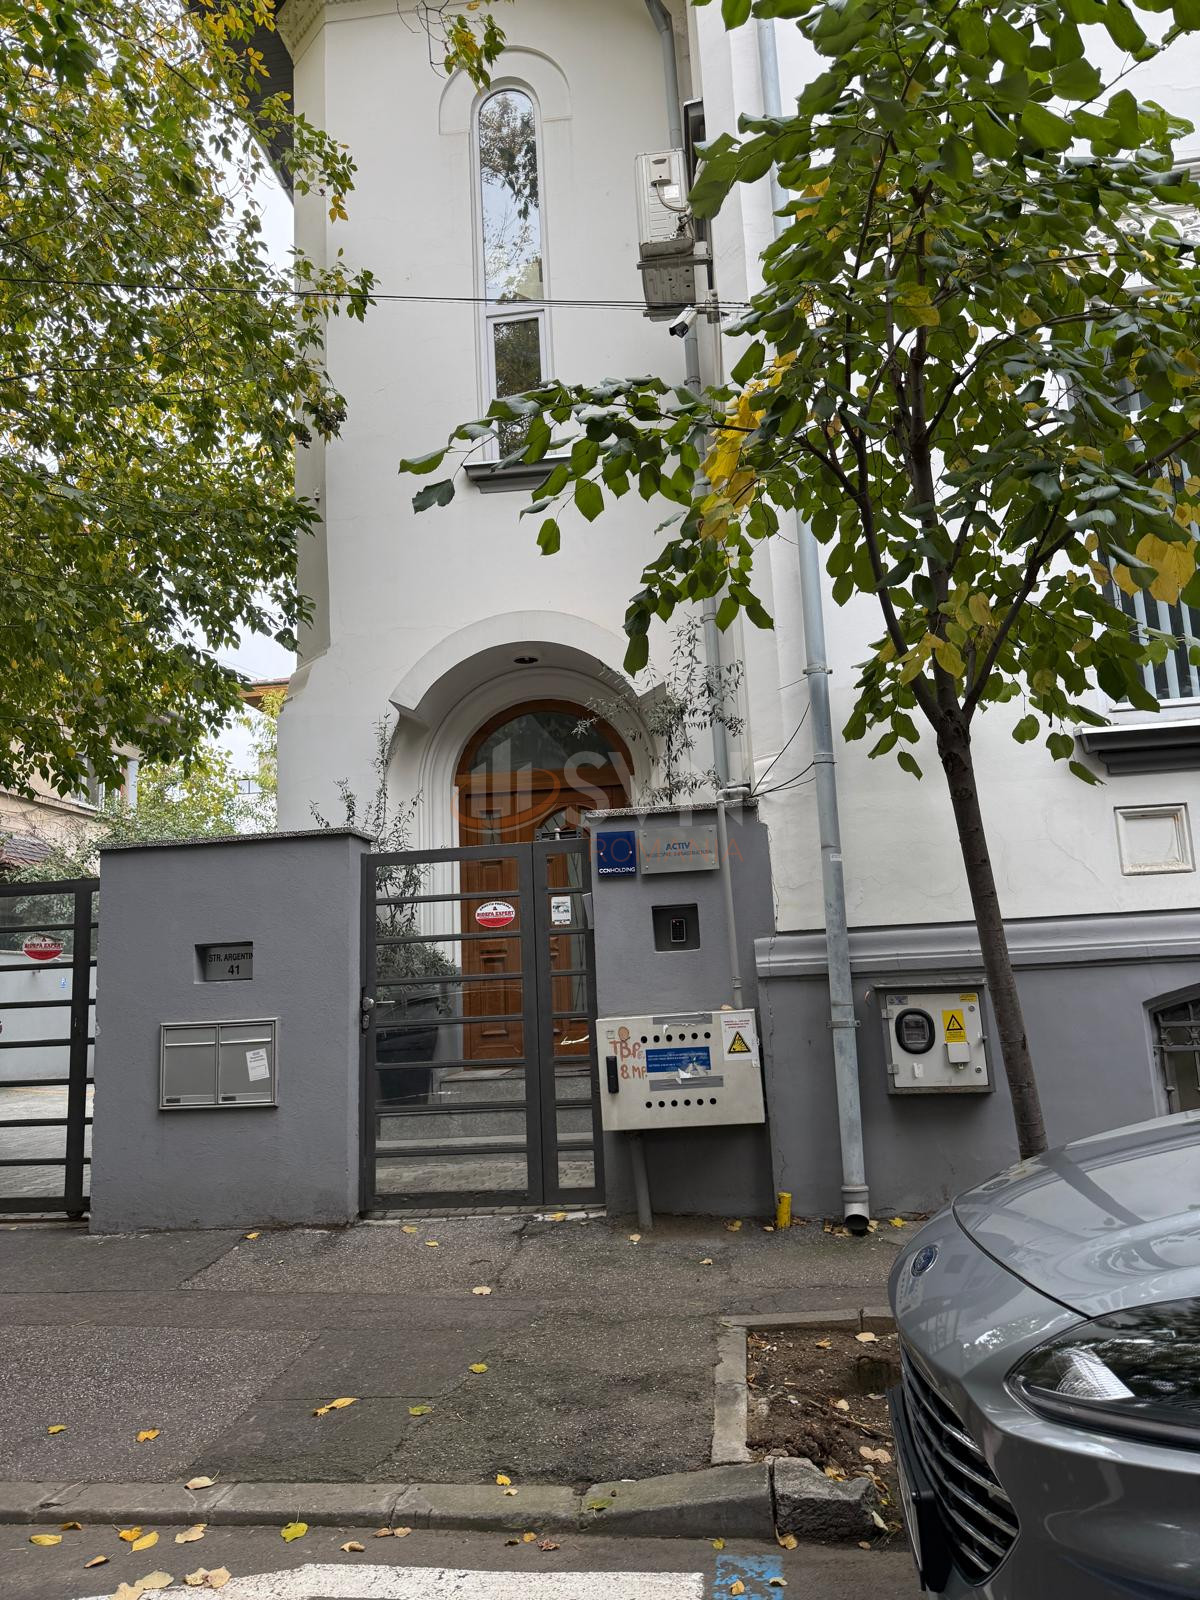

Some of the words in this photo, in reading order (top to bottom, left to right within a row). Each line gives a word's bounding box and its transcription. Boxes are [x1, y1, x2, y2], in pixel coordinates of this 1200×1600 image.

[666, 842, 690, 850] ACTIV
[208, 954, 222, 962] STR.
[227, 964, 240, 976] 41
